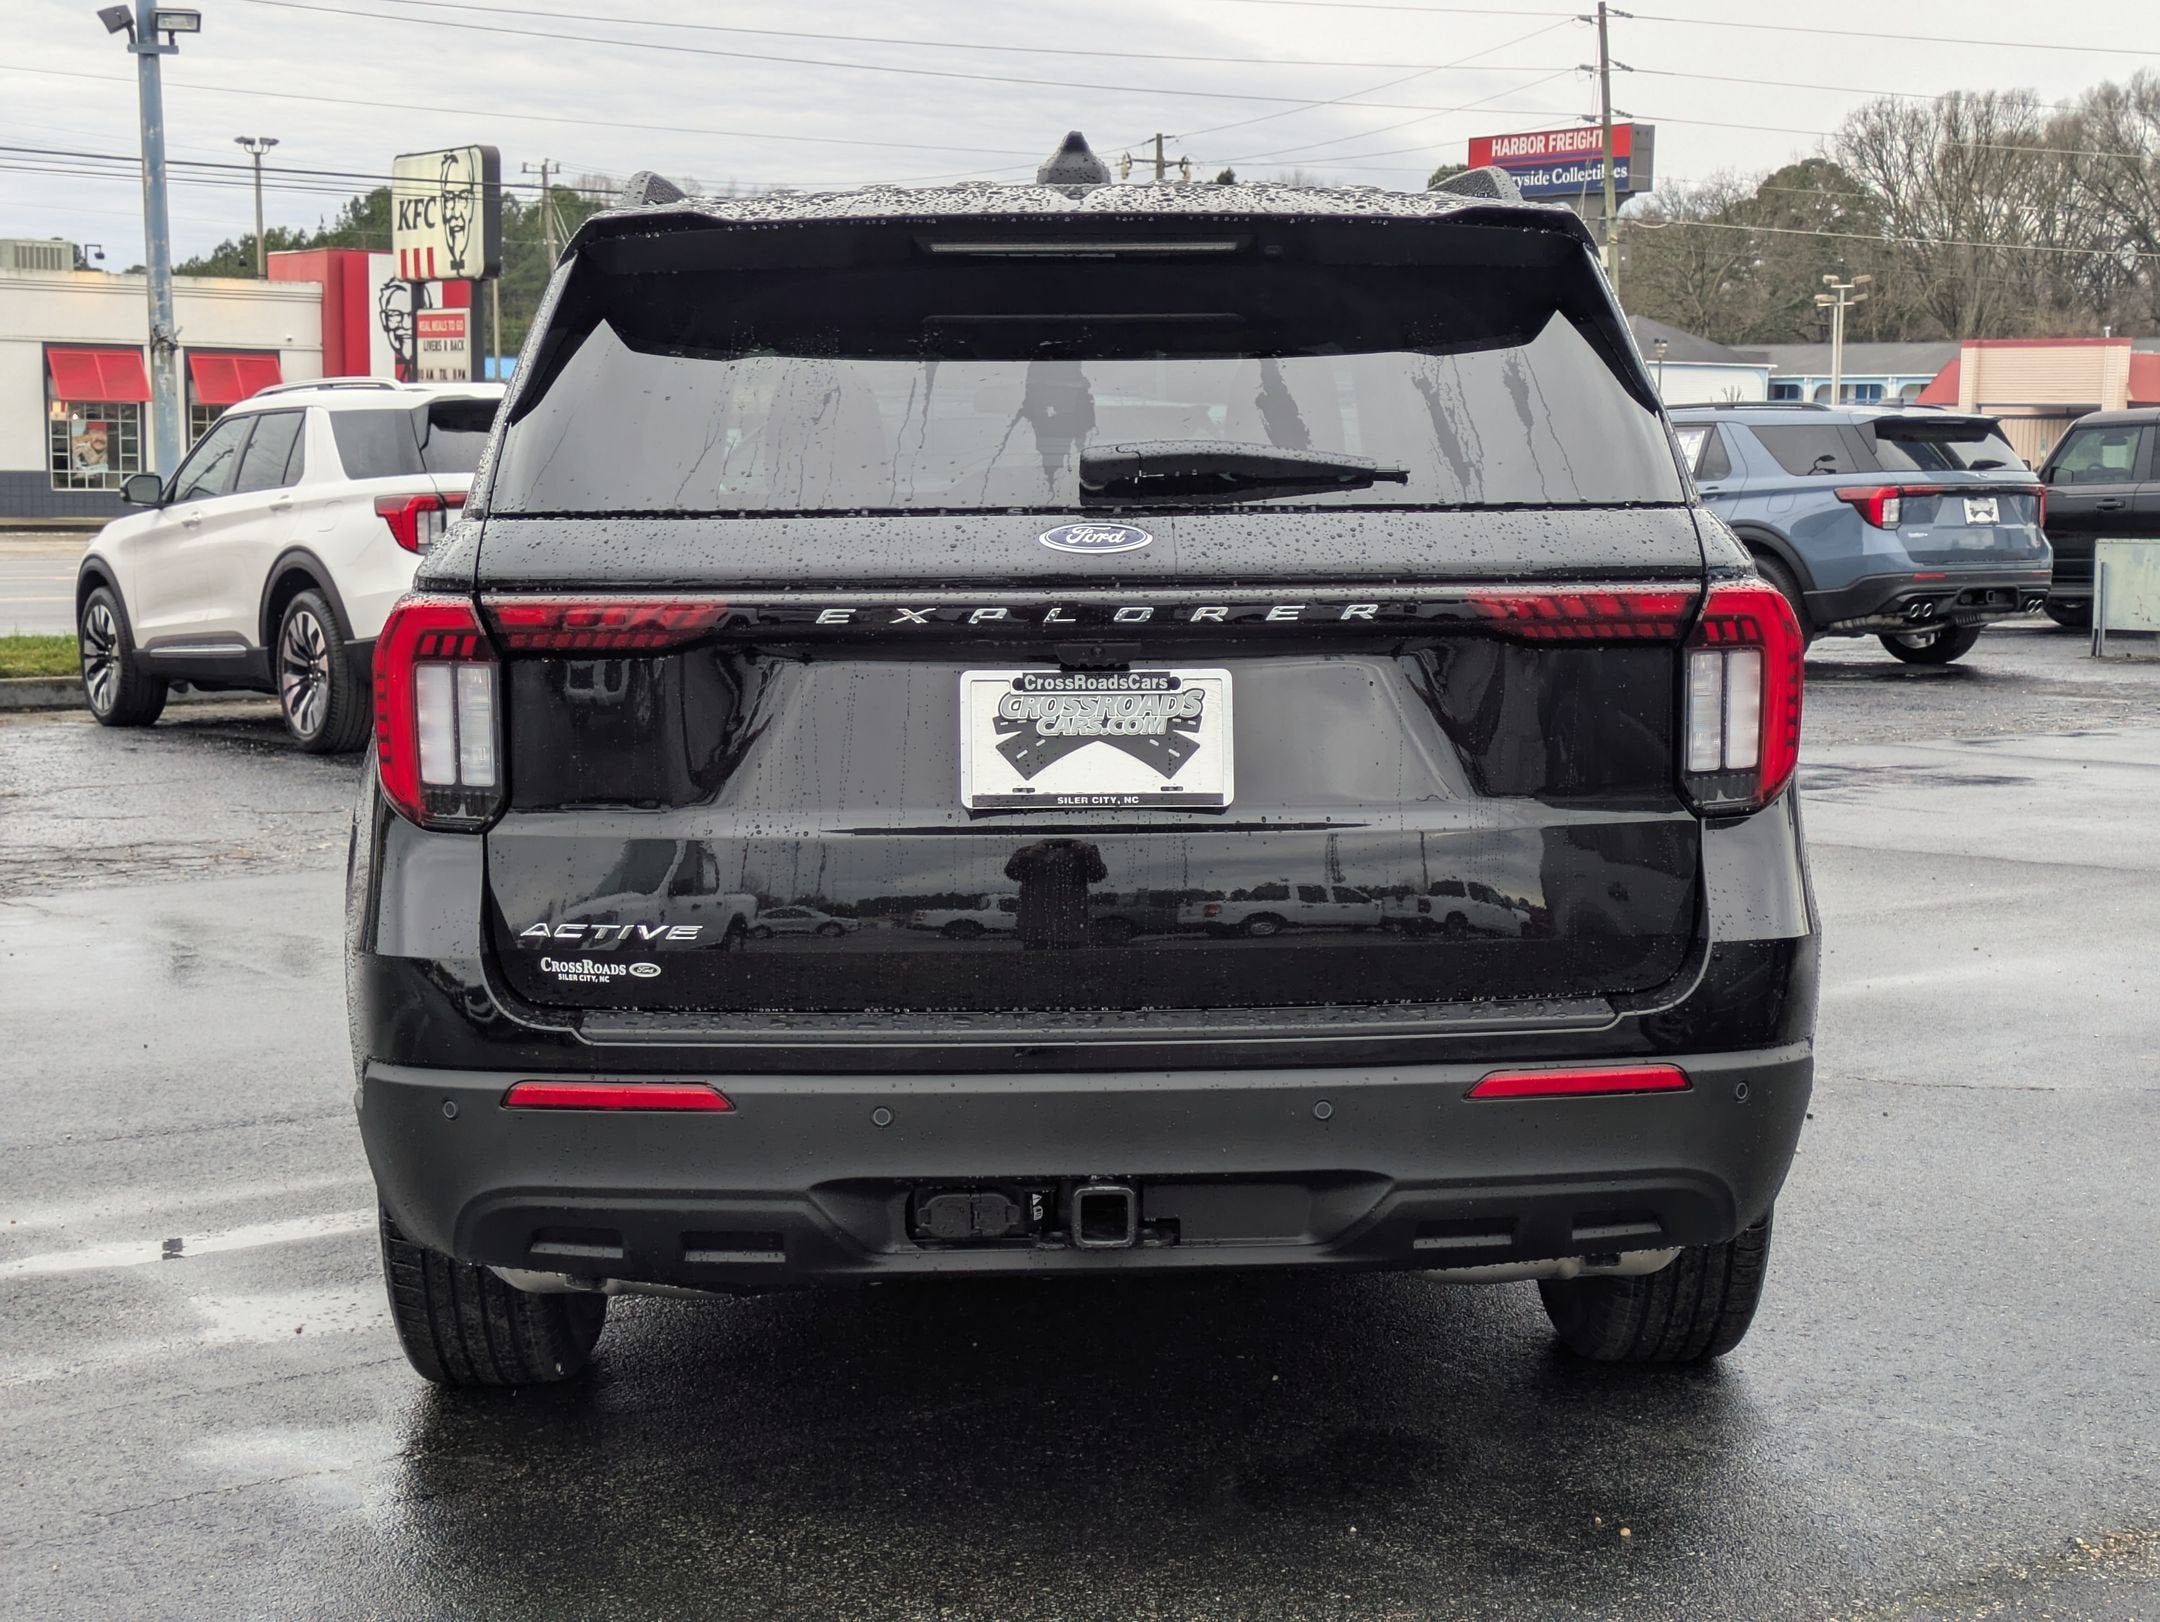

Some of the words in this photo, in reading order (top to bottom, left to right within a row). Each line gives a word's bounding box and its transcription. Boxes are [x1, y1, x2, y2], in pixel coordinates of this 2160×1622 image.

[1491, 135, 1545, 157] HARBOR
[1548, 129, 1603, 152] FREIGHT
[1552, 163, 1628, 184] Collecties
[397, 196, 437, 231] KFC
[423, 340, 442, 351] LIVERS
[450, 340, 464, 351] BACK
[1066, 526, 1126, 544] Ford
[815, 605, 1379, 624] EXPLORER
[1023, 674, 1168, 691] CrossRoadsCars
[998, 689, 1205, 719] CROSSROADS
[1036, 716, 1168, 736] CARS.COM
[1057, 796, 1088, 805] SILER
[1091, 796, 1121, 805] CITY,
[1124, 796, 1140, 804] NC
[520, 922, 704, 941] ACTIVE
[558, 973, 578, 981] SILER
[579, 974, 598, 983] CITY,
[599, 975, 610, 983] NC
